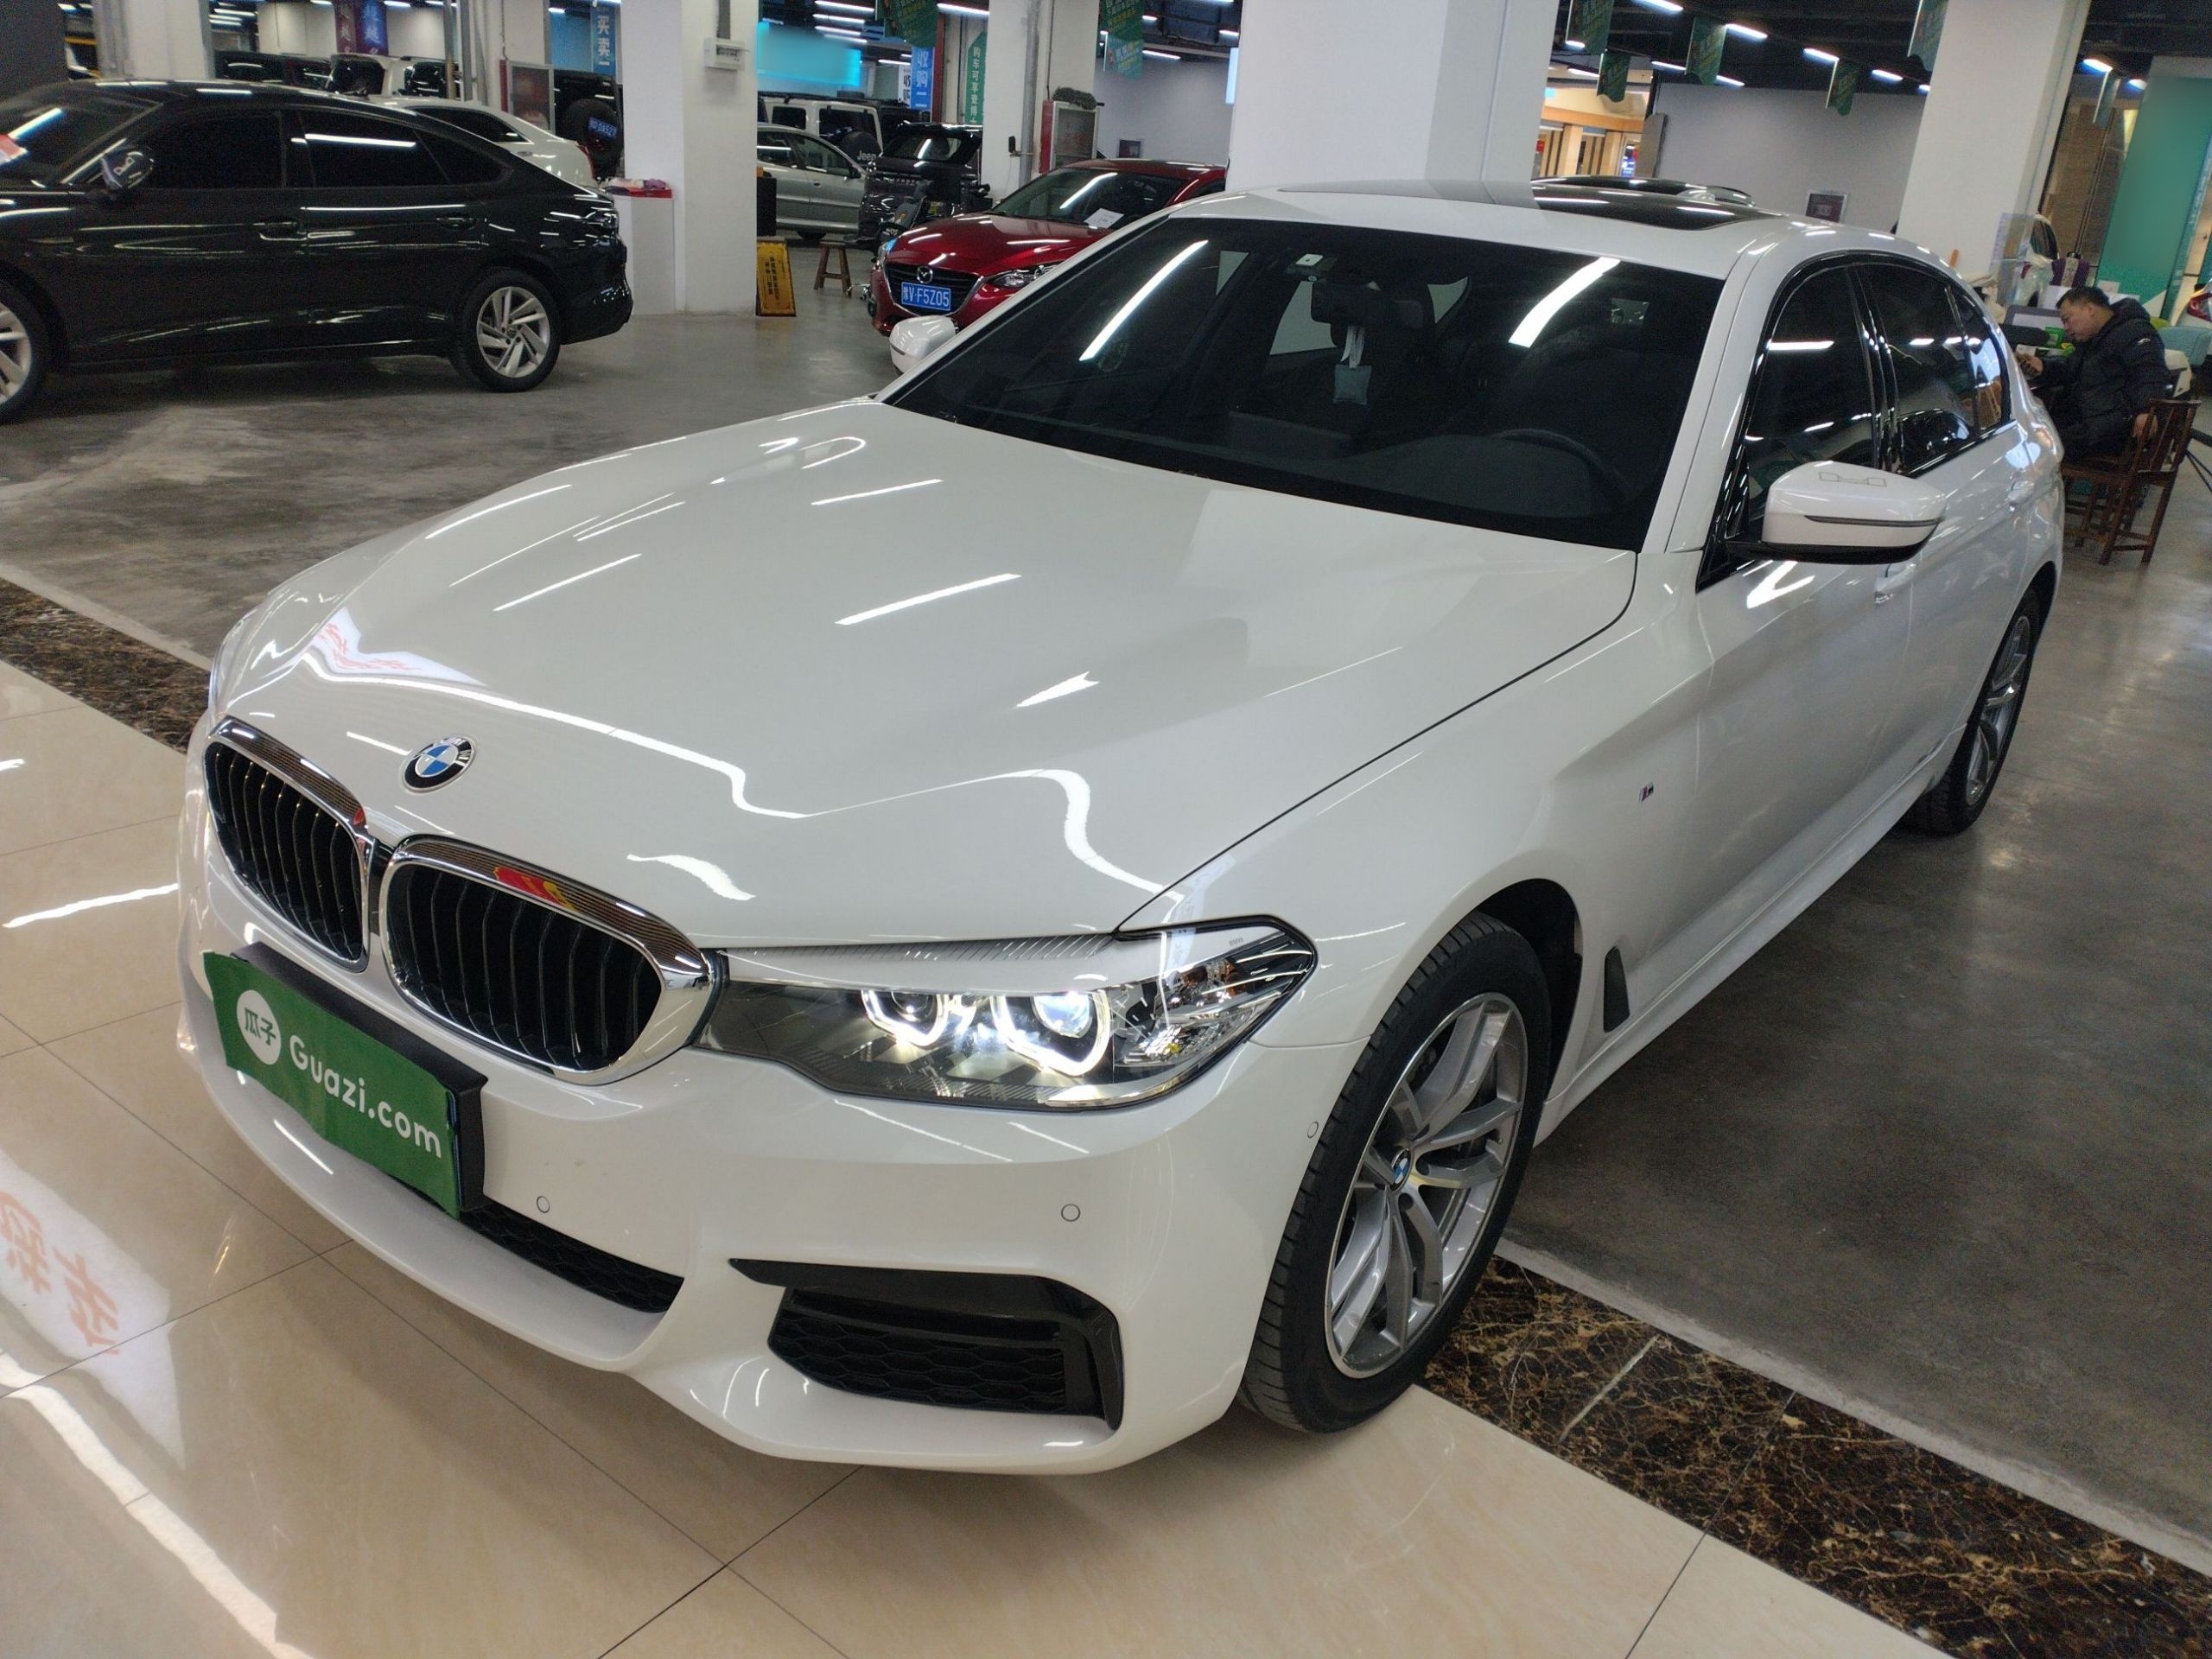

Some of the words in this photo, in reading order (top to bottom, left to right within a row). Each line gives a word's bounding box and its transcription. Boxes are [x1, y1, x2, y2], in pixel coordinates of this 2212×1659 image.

[857, 150, 877, 162] Jeep
[245, 1007, 276, 1046] 瓜子
[289, 1034, 442, 1158] Guazi.com
